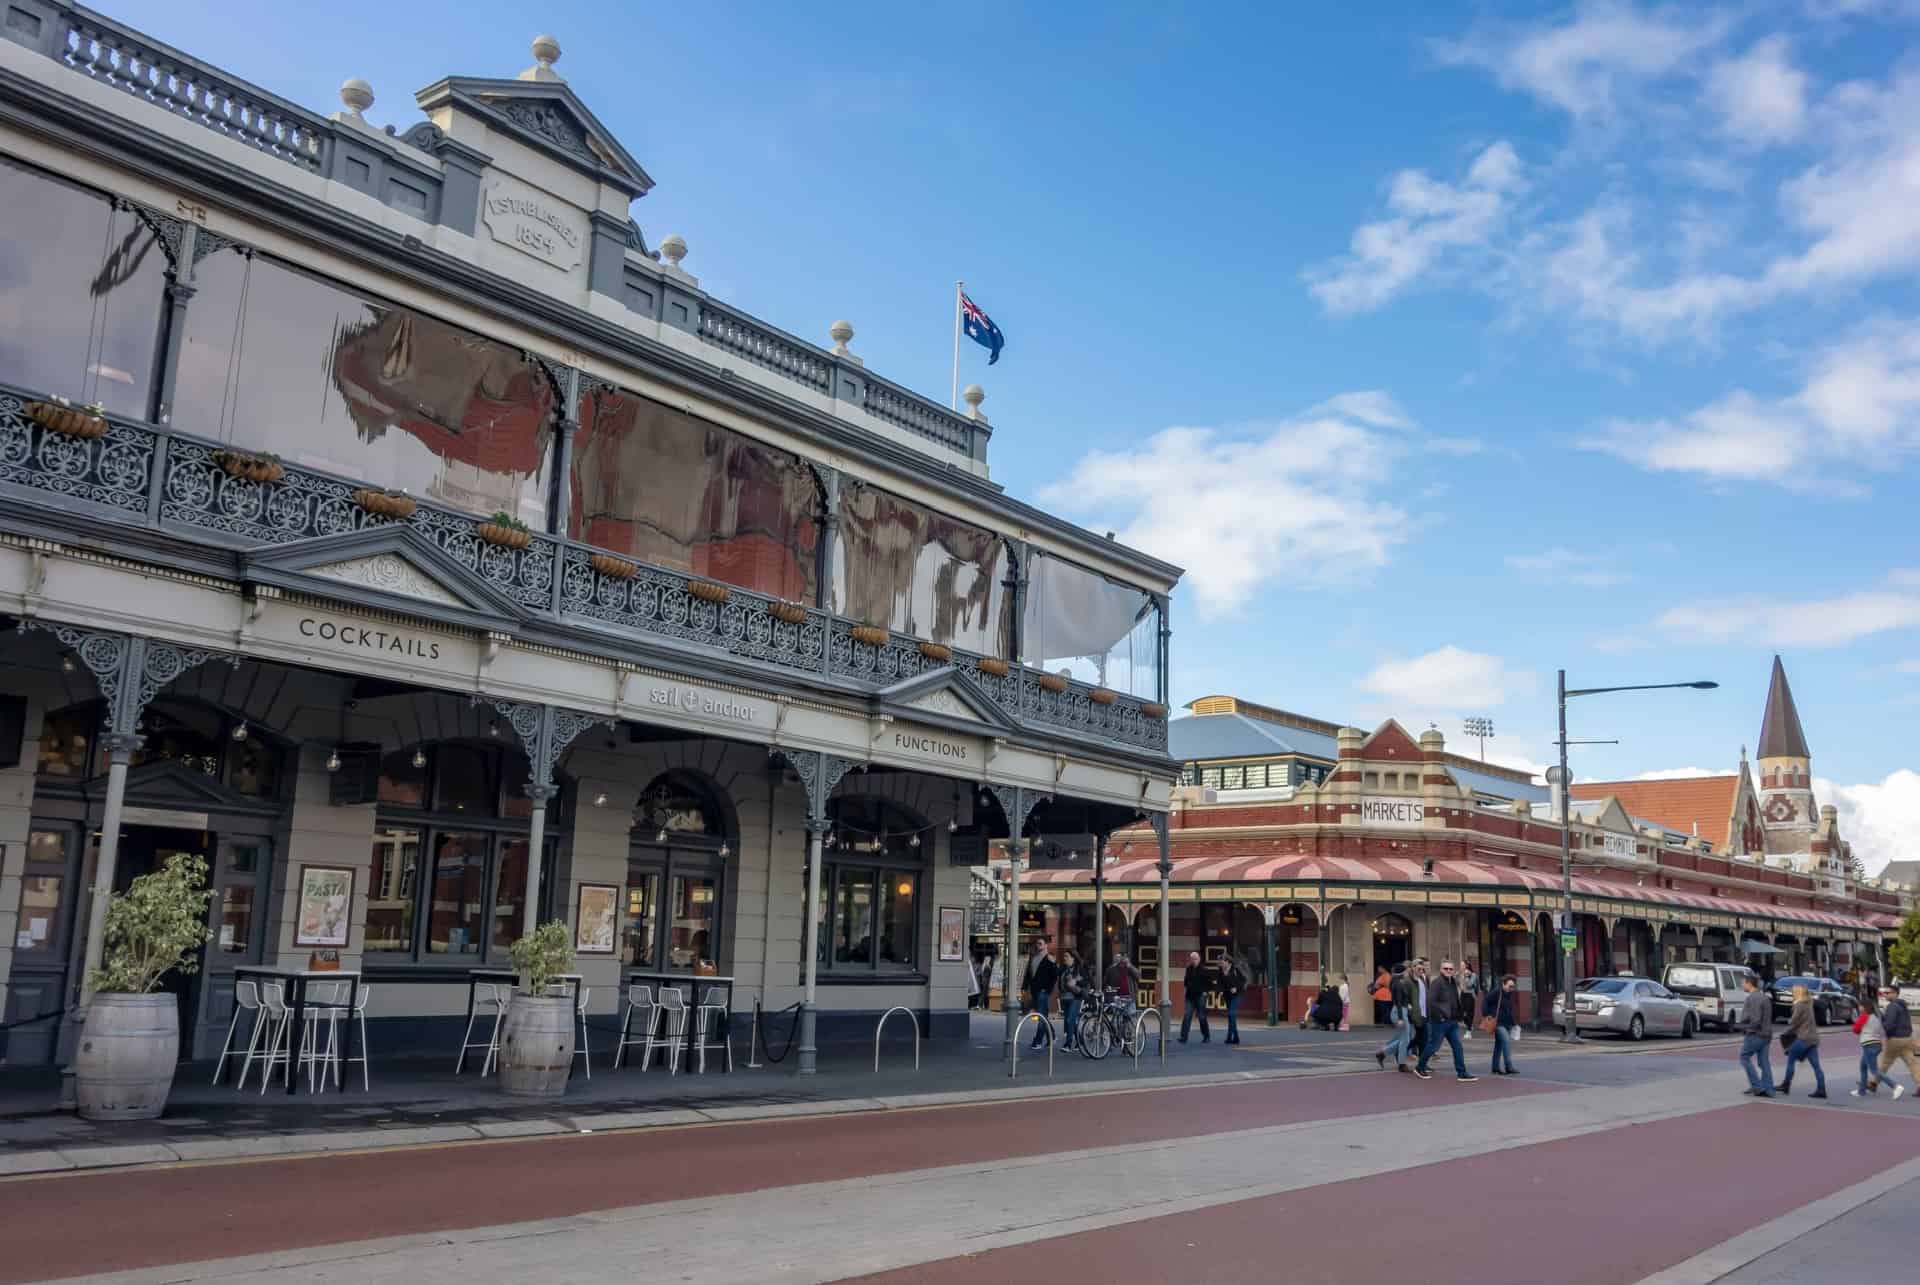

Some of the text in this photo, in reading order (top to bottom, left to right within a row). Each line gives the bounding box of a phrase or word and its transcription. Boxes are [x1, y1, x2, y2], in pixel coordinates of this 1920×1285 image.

[299, 618, 440, 659] COCKTAILS
[649, 687, 755, 721] sail anchor
[895, 733, 967, 759] FUNCTIONS
[1363, 801, 1424, 822] MARKETS
[306, 883, 345, 897] PASTA
